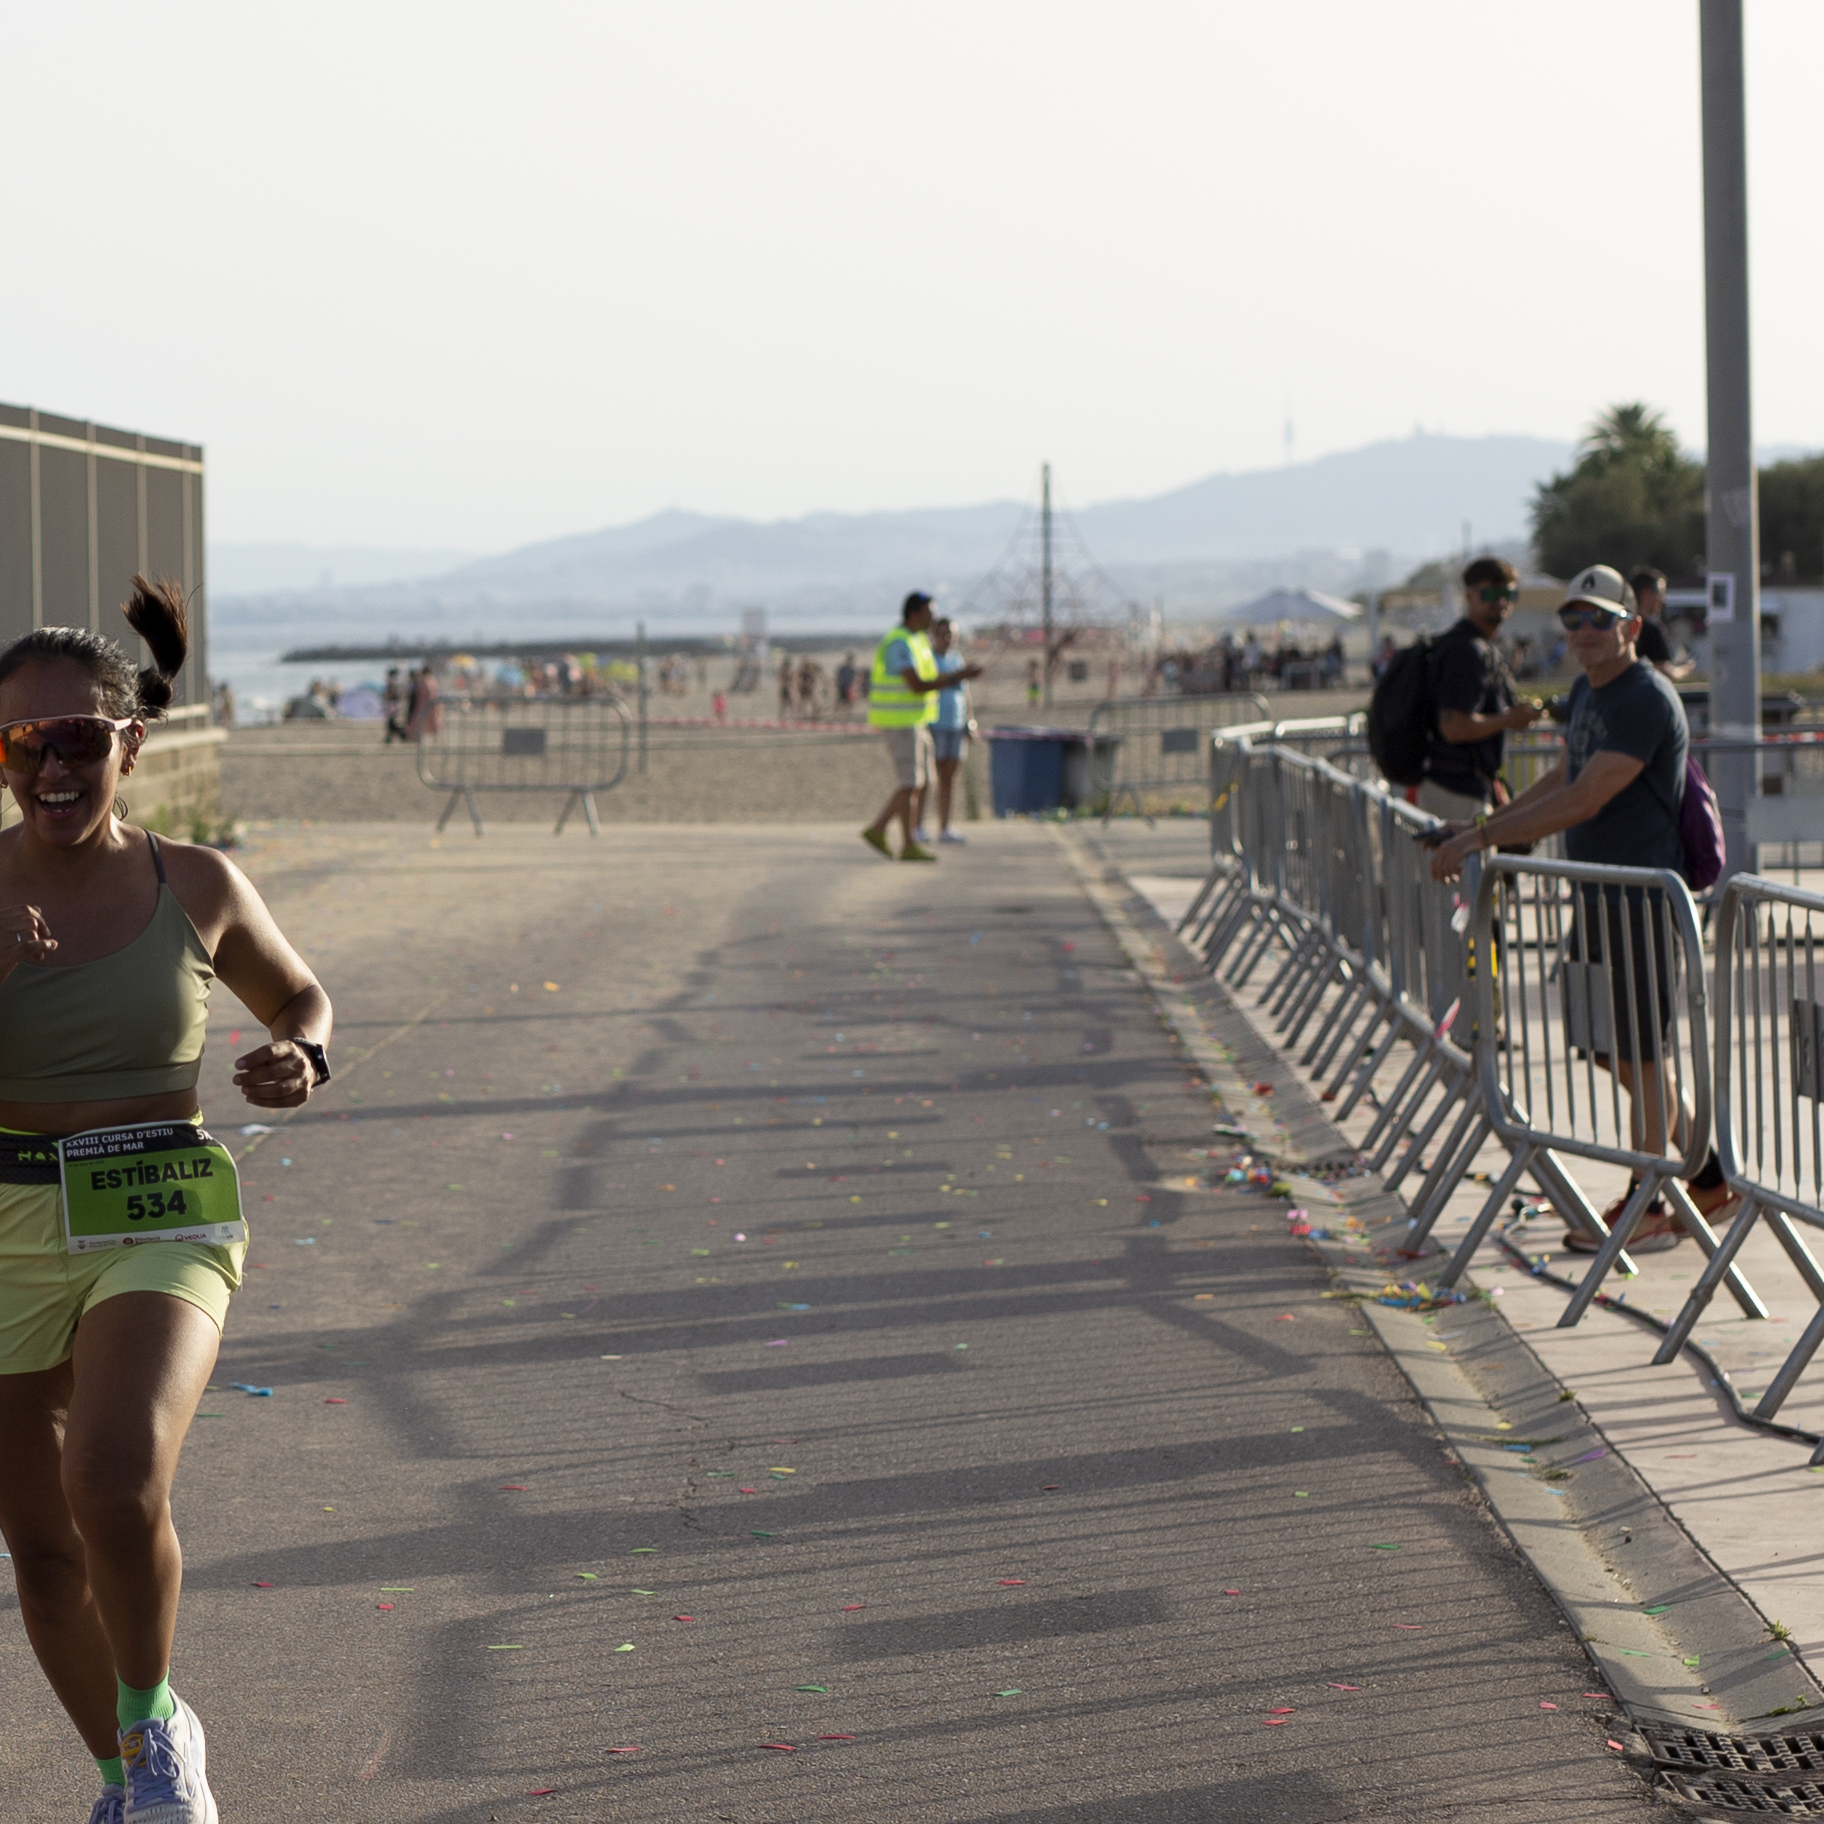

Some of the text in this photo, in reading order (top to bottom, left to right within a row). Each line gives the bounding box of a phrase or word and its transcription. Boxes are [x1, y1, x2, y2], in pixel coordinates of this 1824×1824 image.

[101, 1131, 133, 1143] CURSA
[136, 1127, 174, 1139] D'ESTIU
[66, 1144, 105, 1158] PREMIÀ
[107, 1143, 120, 1154] DE
[123, 1141, 145, 1152] MAR
[90, 1157, 214, 1191] ESTÍBALIZ
[127, 1189, 188, 1221] 534
